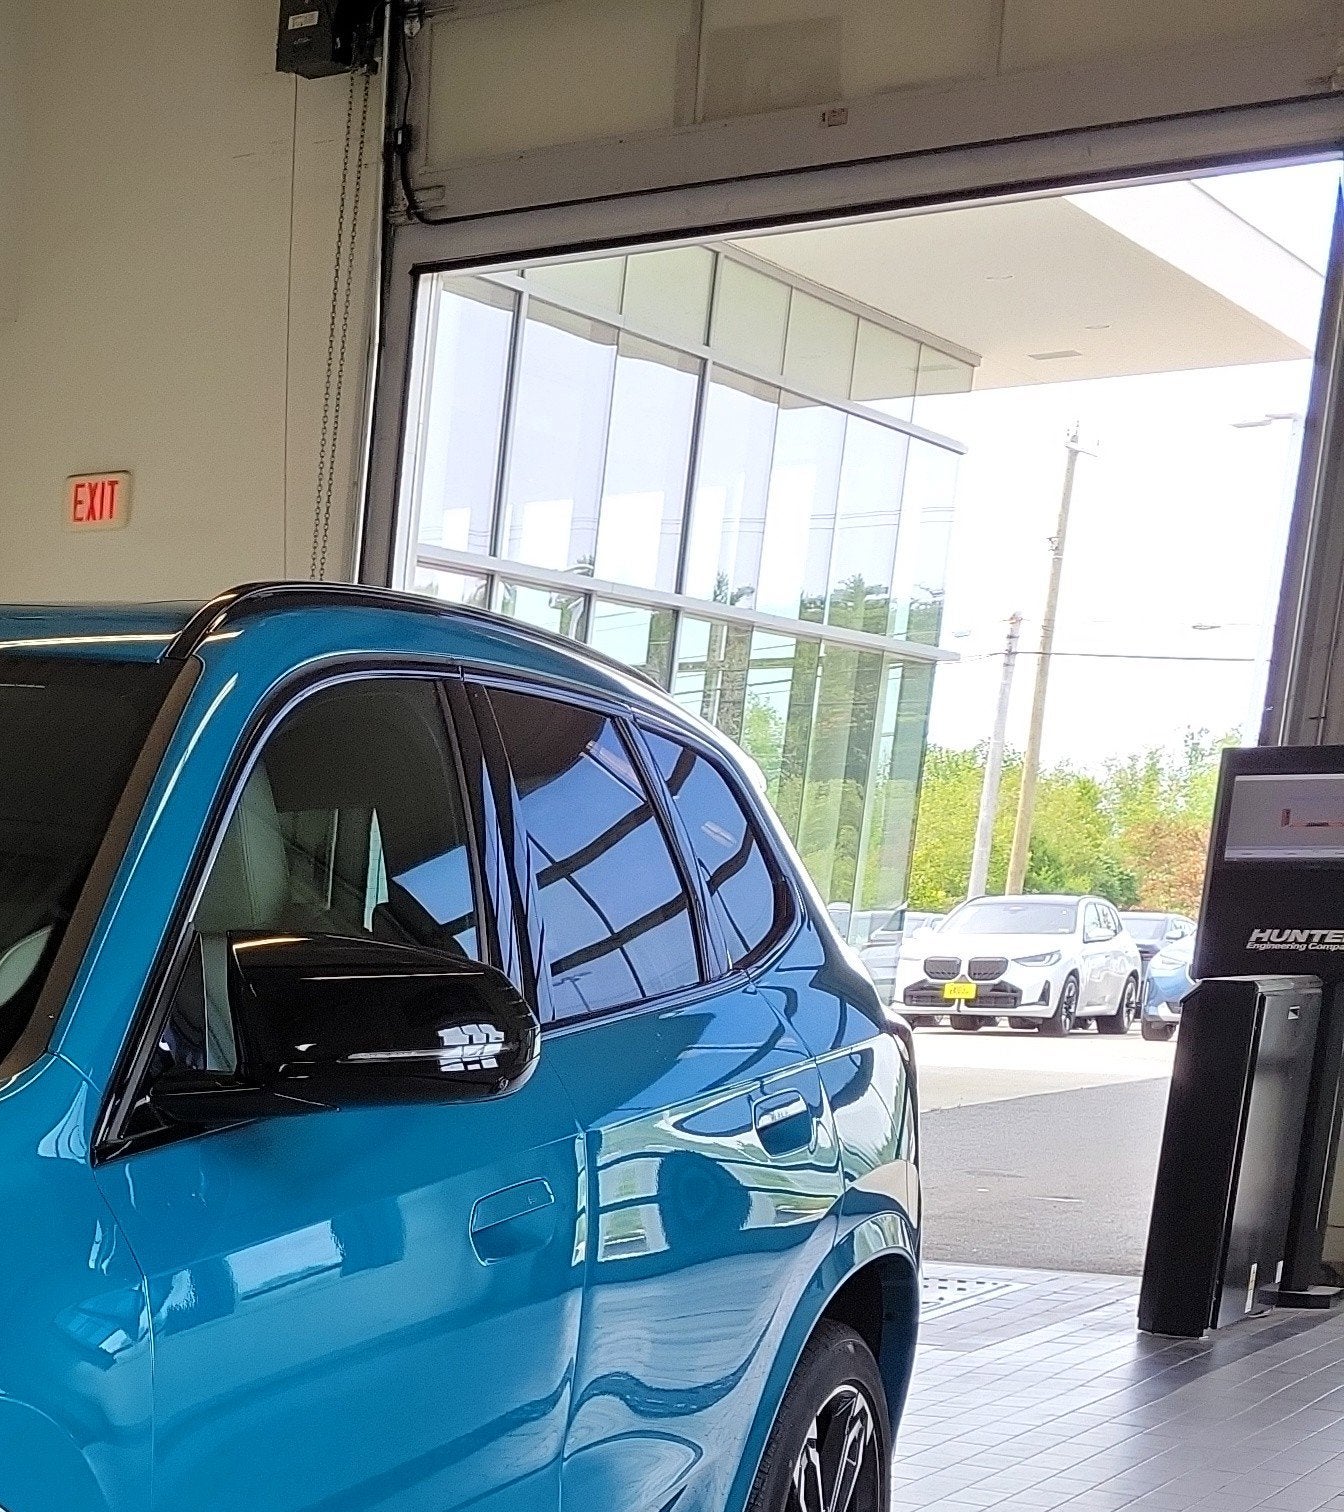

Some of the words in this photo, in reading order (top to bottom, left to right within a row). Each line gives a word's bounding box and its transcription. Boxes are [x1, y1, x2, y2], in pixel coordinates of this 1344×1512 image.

[73, 480, 118, 522] EXIT
[1249, 929, 1344, 942] HUNTE
[1246, 941, 1307, 951] Engineering
